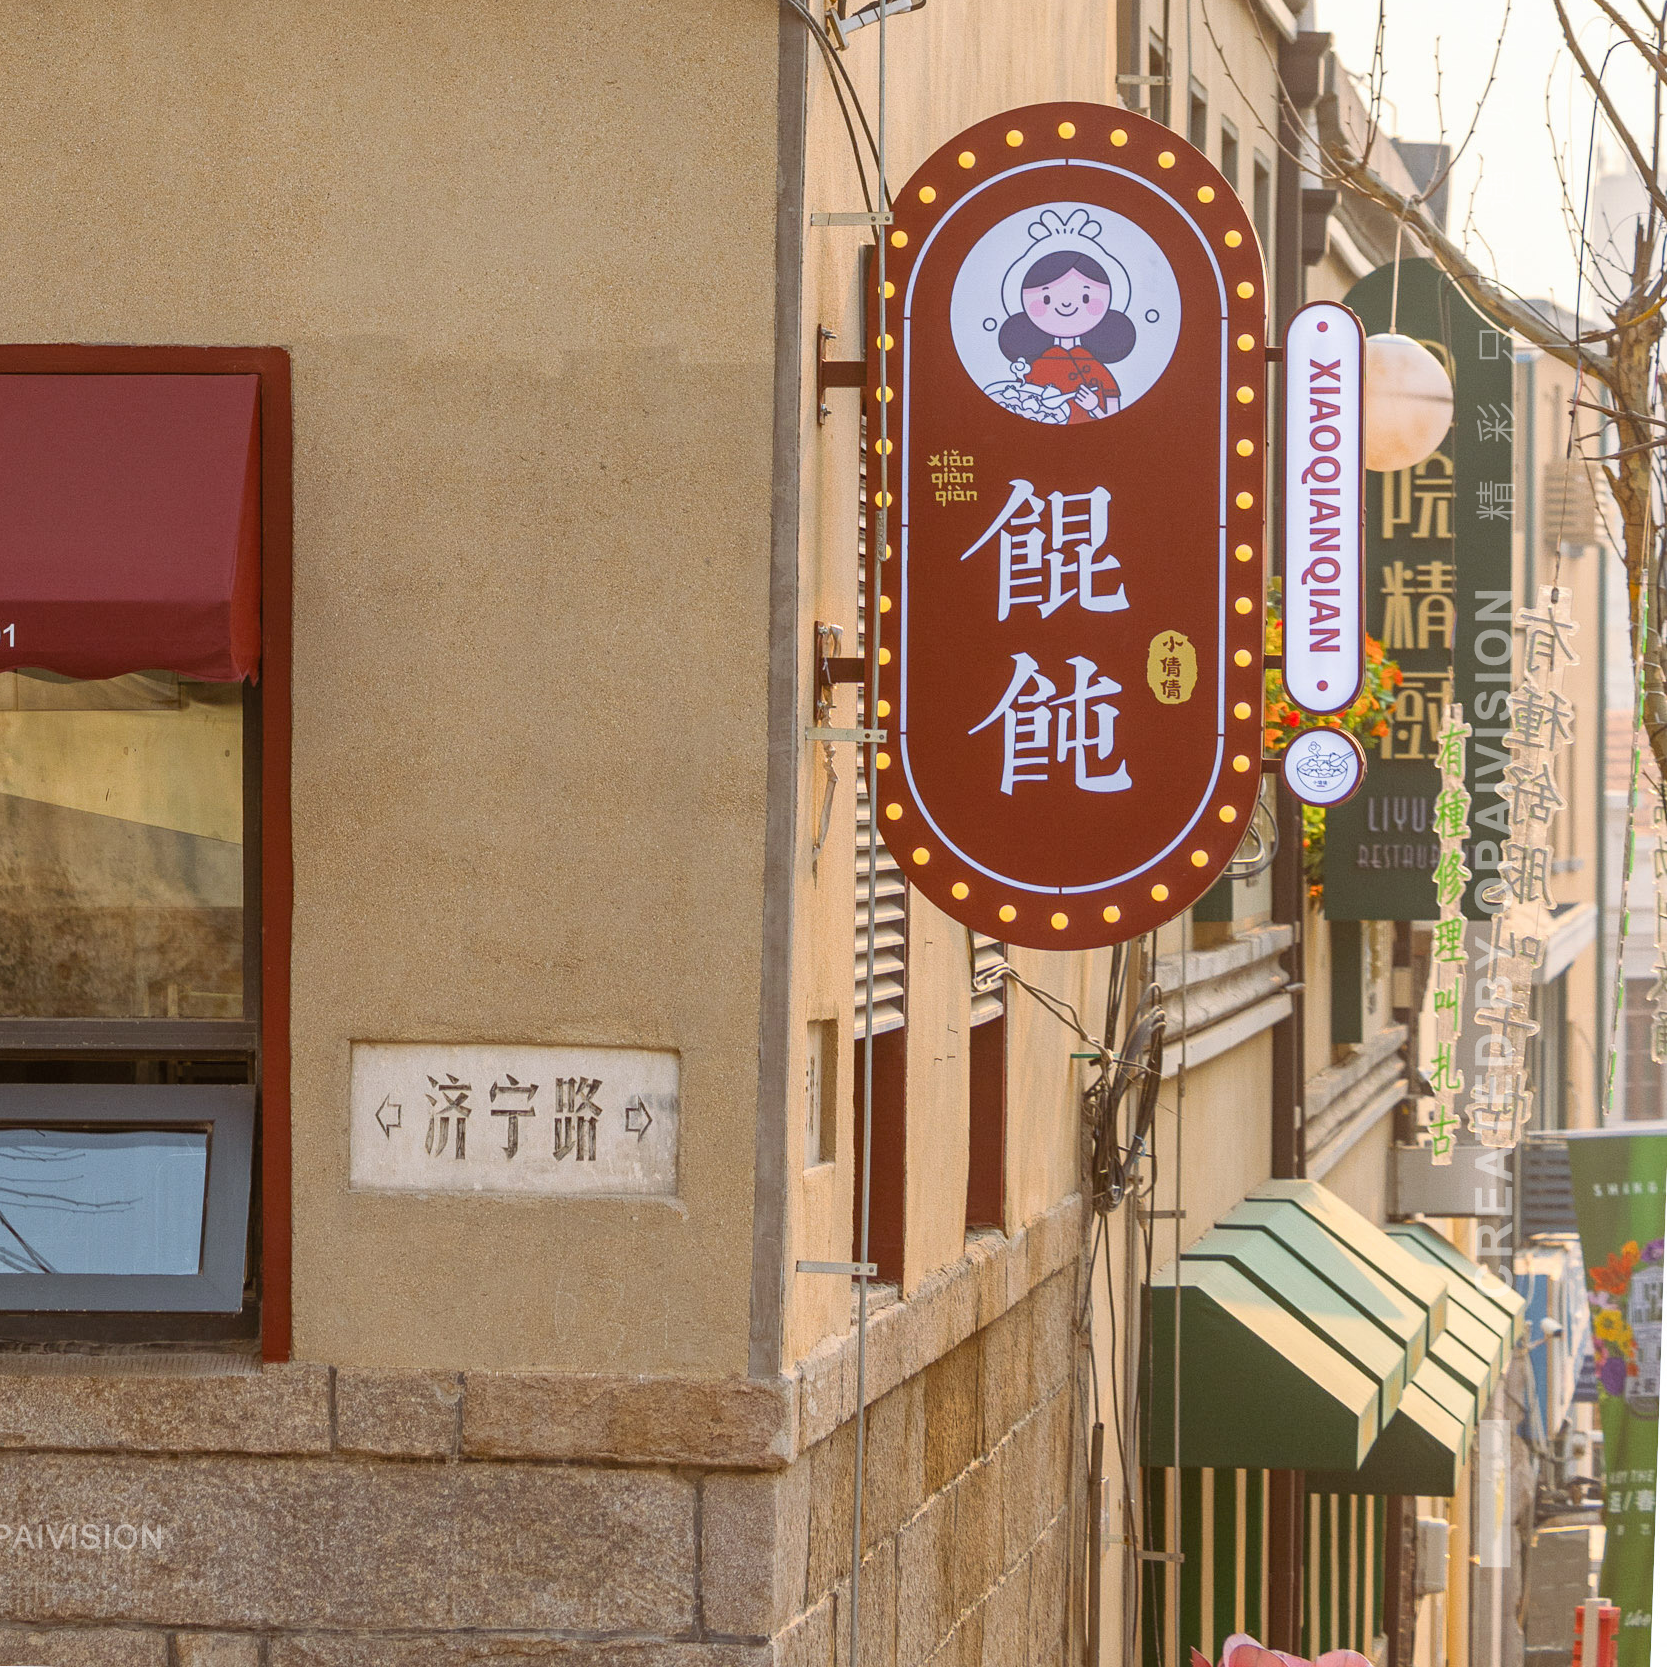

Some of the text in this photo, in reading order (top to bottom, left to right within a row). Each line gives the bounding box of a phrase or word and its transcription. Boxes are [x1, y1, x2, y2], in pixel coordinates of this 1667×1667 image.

[1302, 358, 1342, 654] XIAOQIANQIAN
[960, 478, 1133, 796] 餛飩
[1159, 635, 1184, 700] 小倩倩
[1368, 796, 1433, 832] LIYU
[1430, 722, 1470, 1157] 有種修理叫扎古
[424, 1073, 604, 1162] 济宁路
